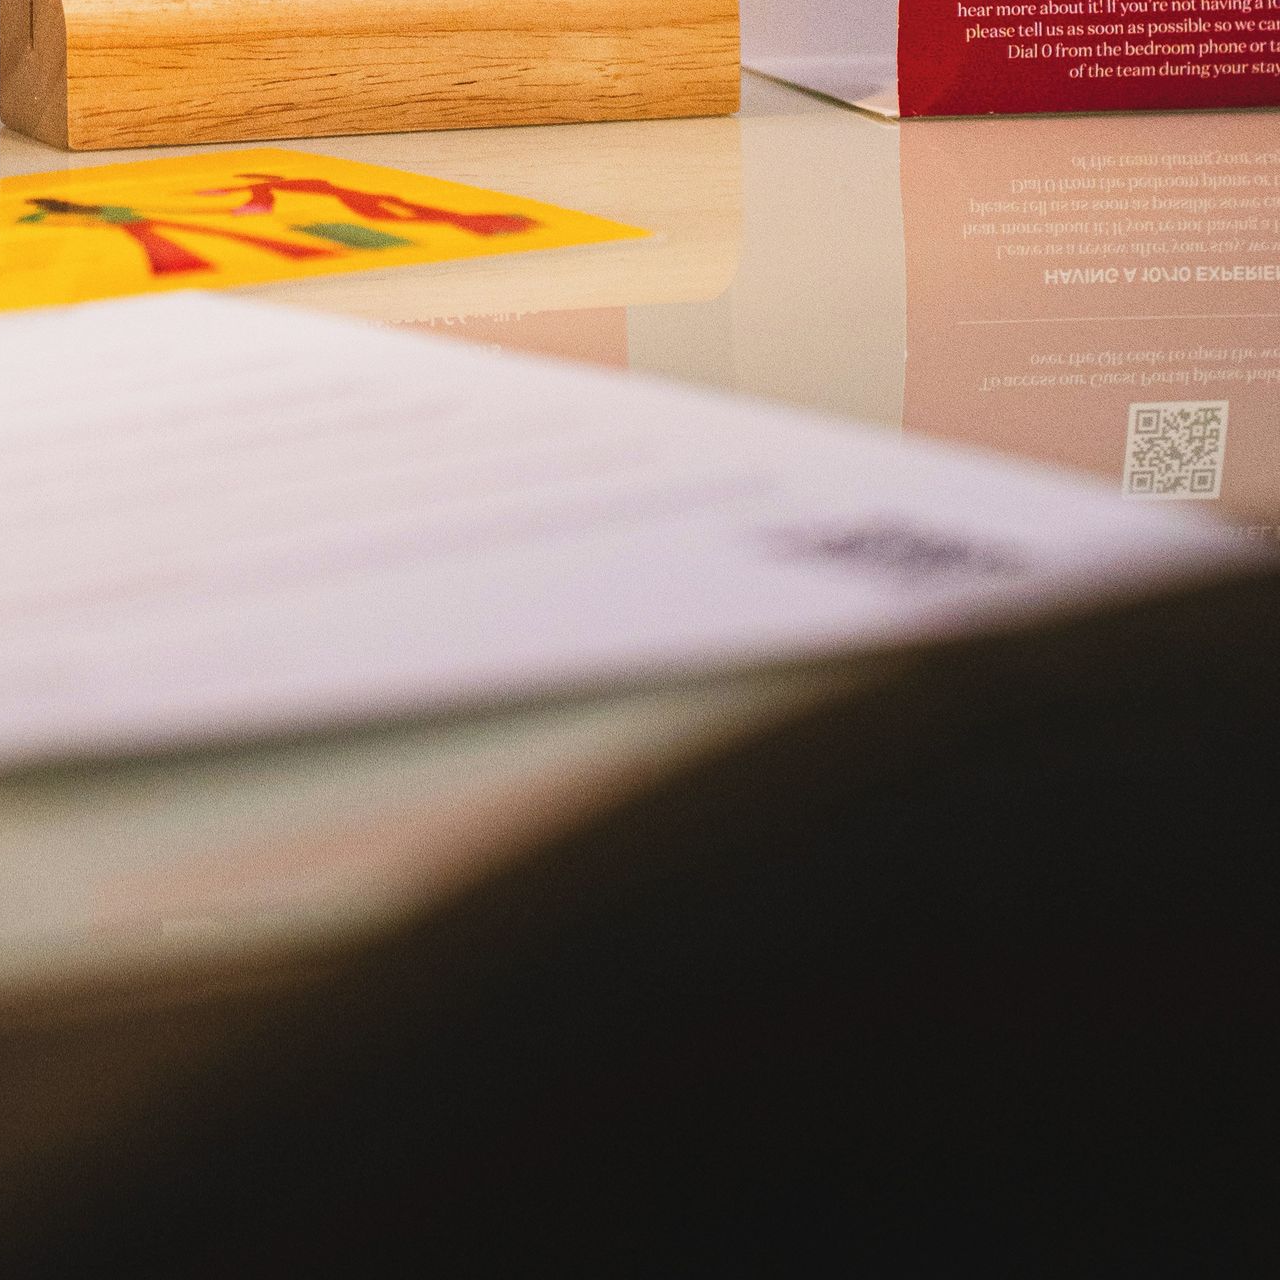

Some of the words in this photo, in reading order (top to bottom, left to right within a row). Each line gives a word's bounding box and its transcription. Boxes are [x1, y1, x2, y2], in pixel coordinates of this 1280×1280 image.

[957, 1, 994, 18] hear
[996, 4, 1037, 17] more
[1039, 0, 1084, 15] about
[1088, 0, 1104, 14] it!
[1171, 0, 1197, 12] not
[965, 23, 1016, 43] please
[1018, 21, 1043, 38] tell
[1046, 25, 1064, 37] us
[1066, 25, 1085, 36] as
[1087, 23, 1124, 35] soon
[1127, 23, 1145, 35] as
[1147, 17, 1212, 38] possible
[1214, 21, 1232, 32] so
[1234, 20, 1256, 32] we
[1008, 43, 1038, 59] Dial
[1041, 43, 1053, 58] 0
[1055, 42, 1093, 58] from
[1096, 41, 1122, 57] the
[1124, 40, 1195, 56] bedroom
[1198, 38, 1247, 58] phone
[1249, 41, 1267, 53] or
[1069, 63, 1086, 78] of
[1087, 62, 1114, 77] the
[1116, 65, 1156, 78] team
[1158, 61, 1211, 78] during
[1213, 63, 1250, 78] your
